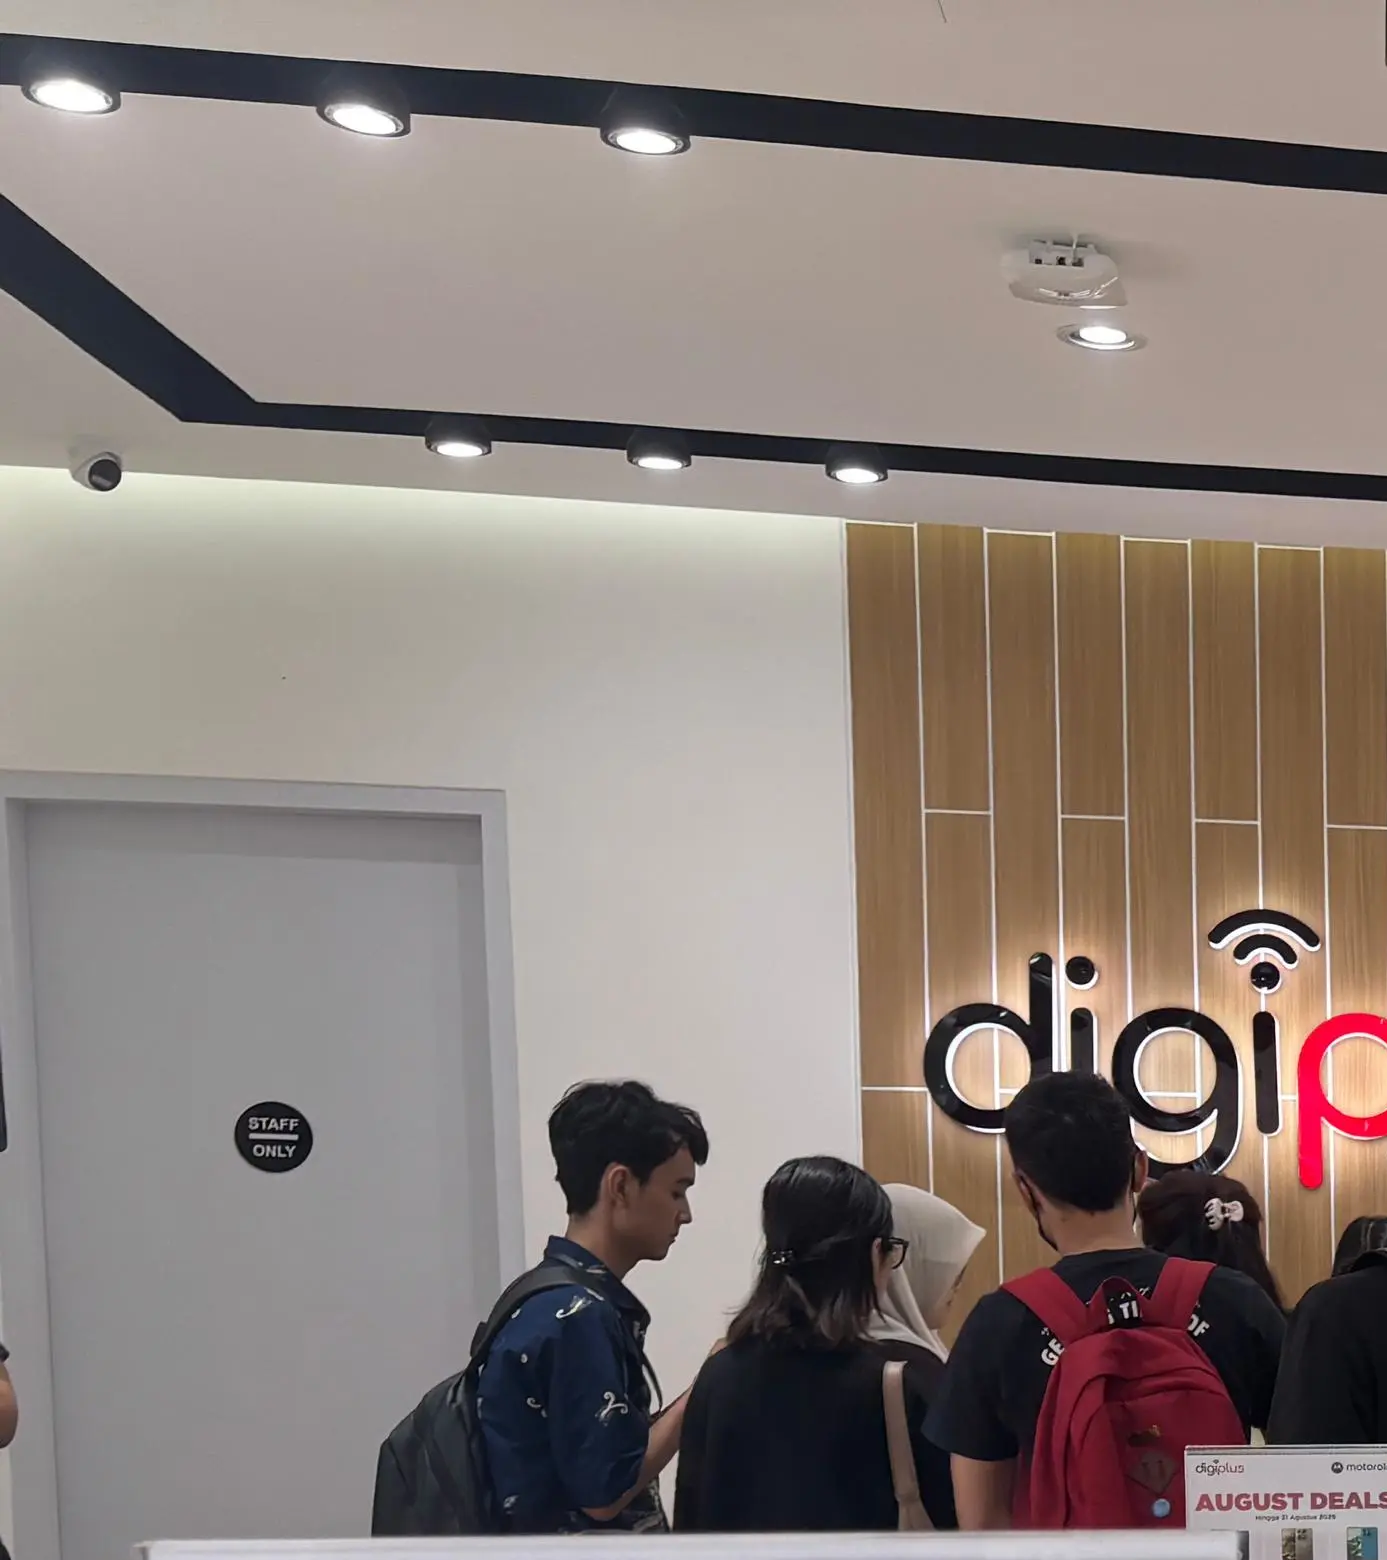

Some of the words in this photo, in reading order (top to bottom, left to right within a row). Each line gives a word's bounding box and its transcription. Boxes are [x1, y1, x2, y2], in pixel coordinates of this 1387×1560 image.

[248, 1116, 300, 1131] STAFF
[252, 1143, 297, 1158] ONLY
[1195, 1459, 1245, 1477] digiplus
[1195, 1492, 1304, 1512] AUGUST
